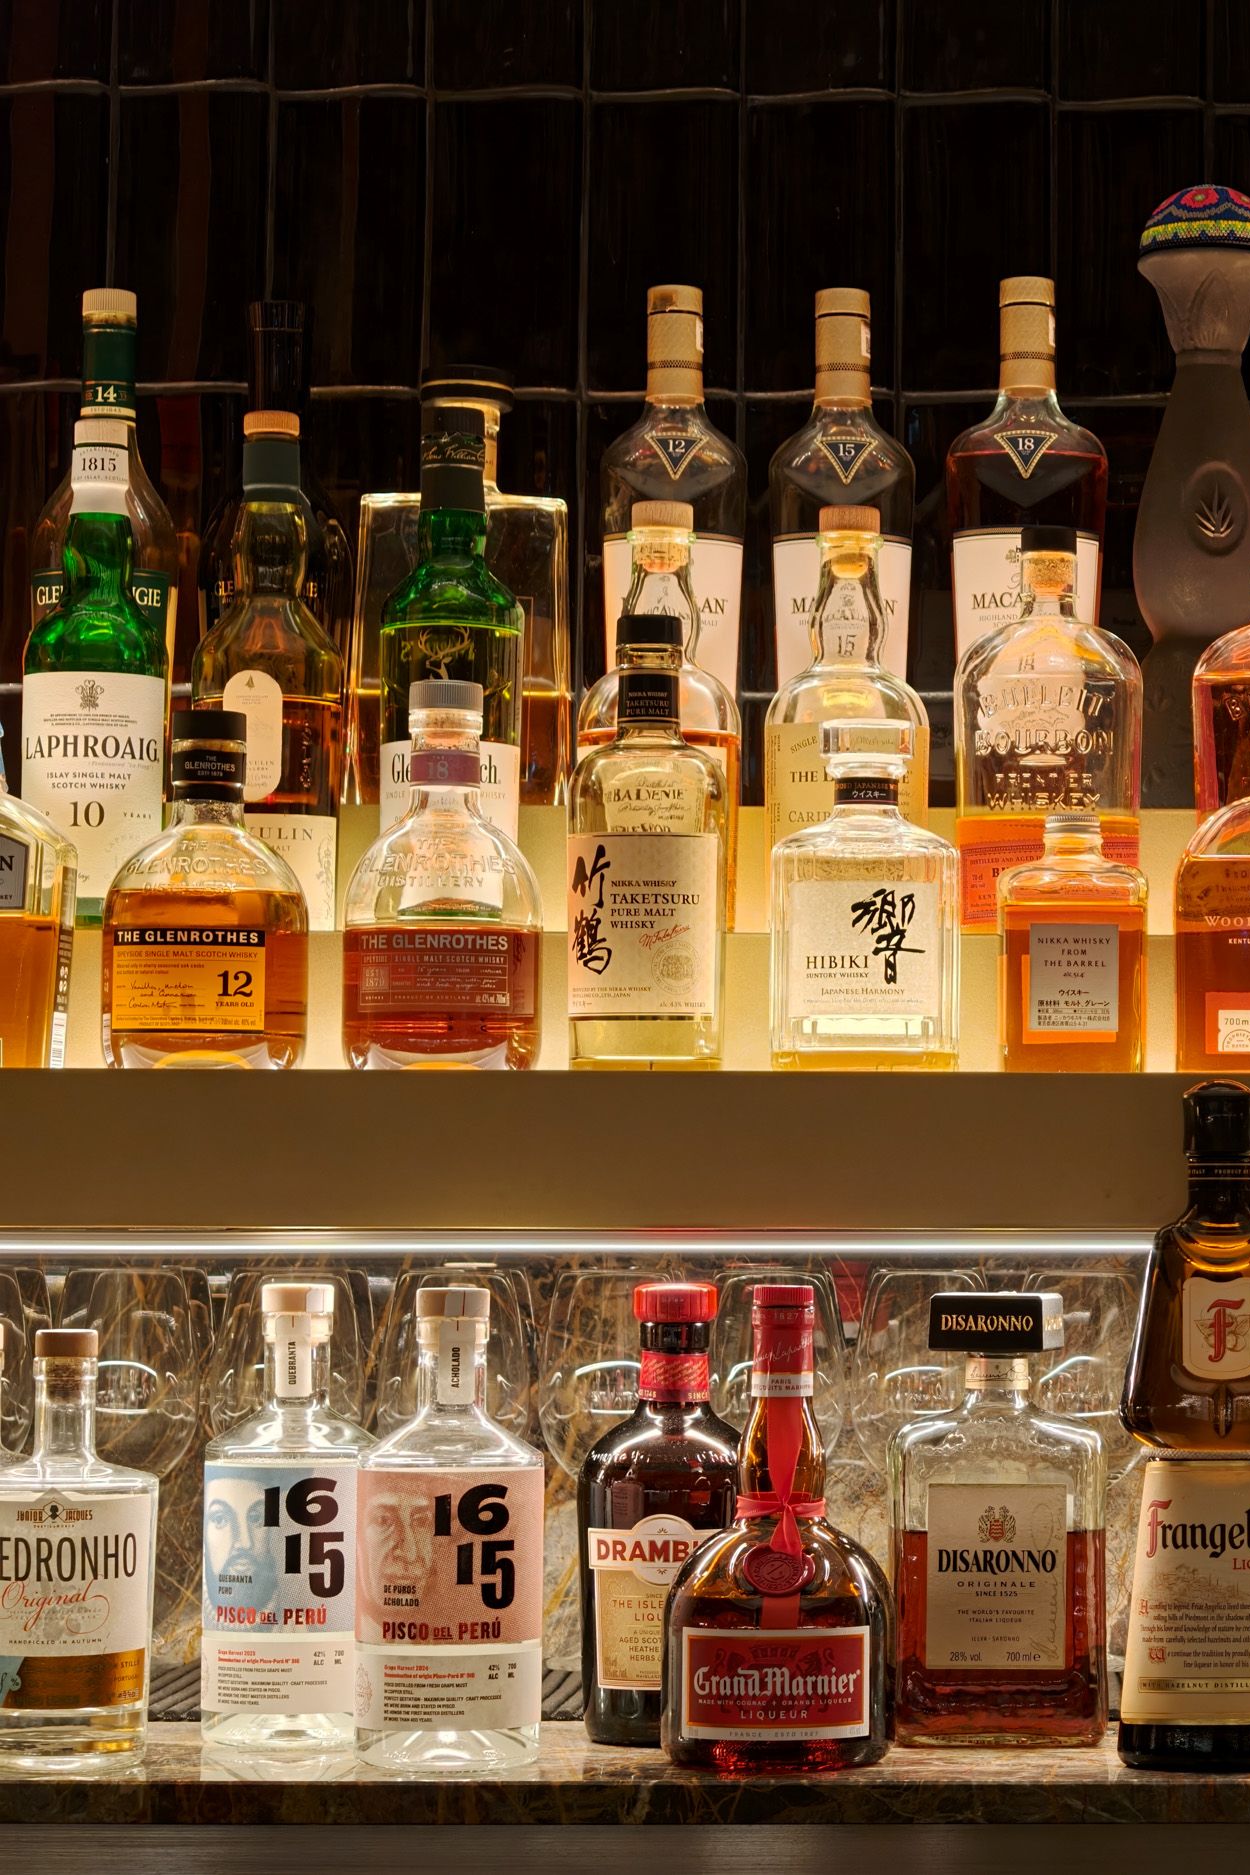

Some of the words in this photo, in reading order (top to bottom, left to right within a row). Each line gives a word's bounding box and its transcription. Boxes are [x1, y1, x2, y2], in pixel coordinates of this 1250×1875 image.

[95, 385, 117, 403] 14
[667, 439, 686, 454] 12
[837, 443, 856, 457] 15
[1017, 437, 1035, 452] 18
[81, 458, 116, 472] 1815
[25, 735, 158, 762] LAPHROAIG
[790, 735, 817, 754] SINGLE
[975, 729, 1113, 755] BOURBON
[72, 771, 105, 779] SINGLE
[185, 761, 236, 772] GLENROTHES
[427, 761, 449, 779] 18
[790, 771, 818, 783] THE
[852, 790, 886, 798] ウイスキー
[987, 792, 1100, 811] WHISKEY
[69, 800, 105, 828] 10
[378, 876, 483, 888] DISTILLERY
[642, 880, 677, 888] WHISKY
[610, 893, 700, 905] TAKETSURU
[611, 908, 640, 917] PURE
[644, 908, 676, 917] MALT
[117, 931, 140, 942] THE
[145, 931, 259, 943] GLENROTHES
[362, 935, 388, 949] THE
[392, 934, 508, 950] GLENROTHES
[851, 888, 926, 985] 響
[806, 955, 869, 969] HIBIKI
[217, 970, 253, 998] 12
[822, 988, 859, 996] JAPANESE
[940, 1314, 1034, 1332] DISARONNO
[1207, 1298, 1246, 1363] F
[288, 1341, 297, 1385] QUEBRANTA
[451, 1346, 461, 1389] ACHOLADO
[263, 1477, 339, 1528] 16
[432, 1483, 510, 1538] 16
[0, 1532, 137, 1582] EDRONHO
[597, 1539, 699, 1563] DRAMB
[284, 1531, 345, 1599] 15
[938, 1549, 1056, 1575] DISARONNO
[218, 1574, 253, 1584] QUEBRANTA
[455, 1539, 516, 1611] 15
[218, 1586, 233, 1595] PURO
[393, 1585, 416, 1594] PUROS
[0, 1575, 102, 1633] Original
[384, 1598, 419, 1607] ACHOLADO
[612, 1600, 633, 1608] THE
[638, 1600, 664, 1609] ISLE
[216, 1605, 256, 1625] PISCO
[260, 1612, 278, 1624] DEL
[283, 1604, 327, 1625] PERÚ
[382, 1621, 429, 1640] PISCO
[433, 1627, 452, 1638] DEL
[459, 1617, 500, 1640] PERÚ
[950, 1652, 967, 1661] 28%
[1006, 1652, 1020, 1661] 700
[694, 1667, 761, 1697] Grand
[761, 1667, 856, 1697] Marnier
[740, 1710, 808, 1720] LIQUEUR
